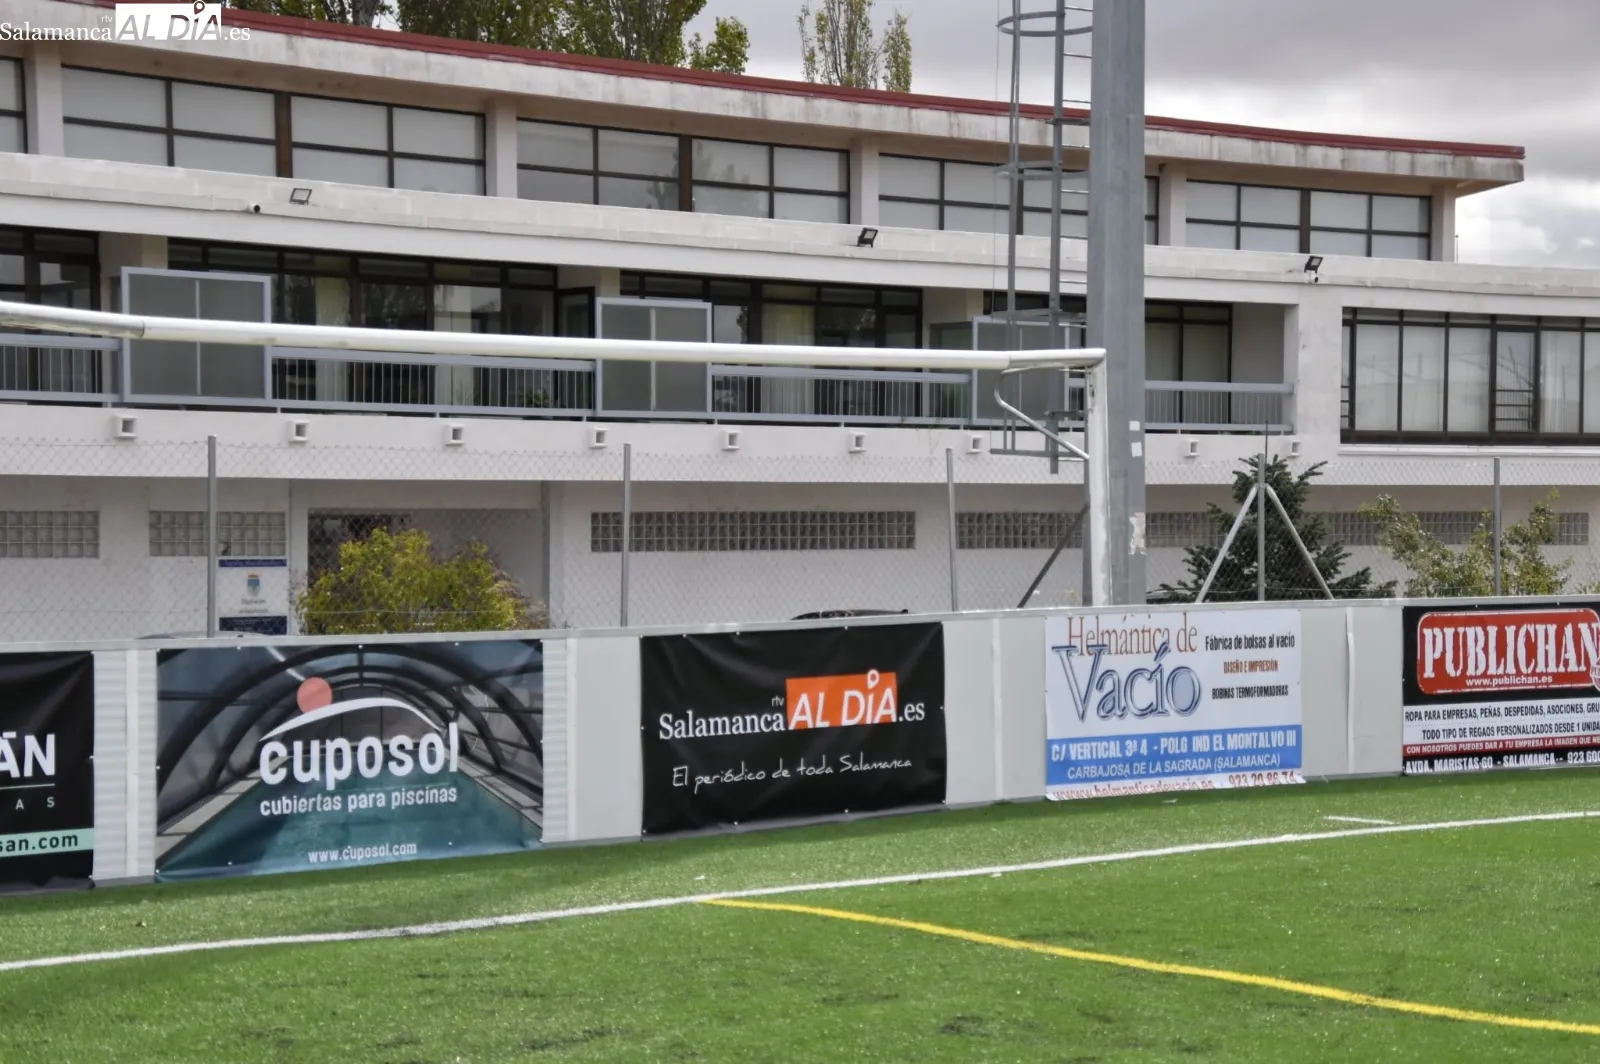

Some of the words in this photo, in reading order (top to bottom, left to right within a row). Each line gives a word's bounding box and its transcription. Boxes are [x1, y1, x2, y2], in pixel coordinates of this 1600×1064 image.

[1176, 612, 1199, 653] de
[1205, 635, 1233, 651] Fábrica
[1234, 634, 1243, 650] de
[1244, 634, 1267, 649] bolsas
[1268, 633, 1275, 649] al
[1276, 631, 1295, 648] vacío
[1423, 623, 1600, 678] PUBLICHAN
[1223, 659, 1243, 674] DISEÑO
[1051, 640, 1202, 724] Vacío
[1212, 687, 1235, 700] BOBINAS
[1236, 685, 1289, 699] TERMOFORMADORAS
[1465, 676, 1553, 687] www.publichan.es
[659, 710, 786, 740] Salamanca
[787, 692, 832, 731] AL
[1405, 711, 1422, 722] ROPA
[1424, 710, 1441, 721] PARA
[1422, 728, 1441, 741] TODO
[1442, 728, 1457, 740] TIPO
[1458, 727, 1468, 738] DE
[1469, 726, 1495, 738] REGAOS
[1496, 723, 1553, 737] PERSONALIZADOS
[1554, 722, 1575, 734] DESDE
[258, 722, 460, 791] cuposol
[1051, 744, 1066, 762] C/
[1069, 740, 1123, 760] VERTICAL
[1140, 739, 1148, 756] 4
[1160, 736, 1188, 755] POLG
[1192, 735, 1210, 753] IND
[1213, 734, 1225, 751] EL
[1227, 731, 1284, 750] MONTALVO
[1406, 746, 1421, 754] CON
[1422, 744, 1457, 753] NOSOTROS
[1458, 742, 1483, 751] PUEDES
[1484, 741, 1498, 749] DAR
[1514, 738, 1544, 748] EMPRESA
[1544, 737, 1553, 746] LA
[1553, 736, 1578, 746] IMAGEN
[1578, 735, 1592, 744] QUE
[672, 766, 689, 787] El
[693, 761, 766, 794] periódico
[771, 758, 791, 778] de
[796, 754, 834, 776] toda
[838, 752, 913, 772] Salamanca
[1067, 763, 1130, 780] CARBAJOSA
[1133, 762, 1147, 775] DE
[1149, 760, 1163, 775] LA
[1164, 757, 1213, 773] SAGRADA
[1214, 754, 1281, 772] (SALAMANCA)
[1405, 760, 1433, 774] AVDA.
[1433, 756, 1480, 772] MARISTAS
[1502, 752, 1556, 768] SALAMANCA
[1567, 751, 1585, 764] 923
[260, 794, 343, 816] cubiertas
[347, 791, 387, 812] para
[391, 786, 458, 809] piscinas
[308, 842, 418, 864] www.cuposol.com
